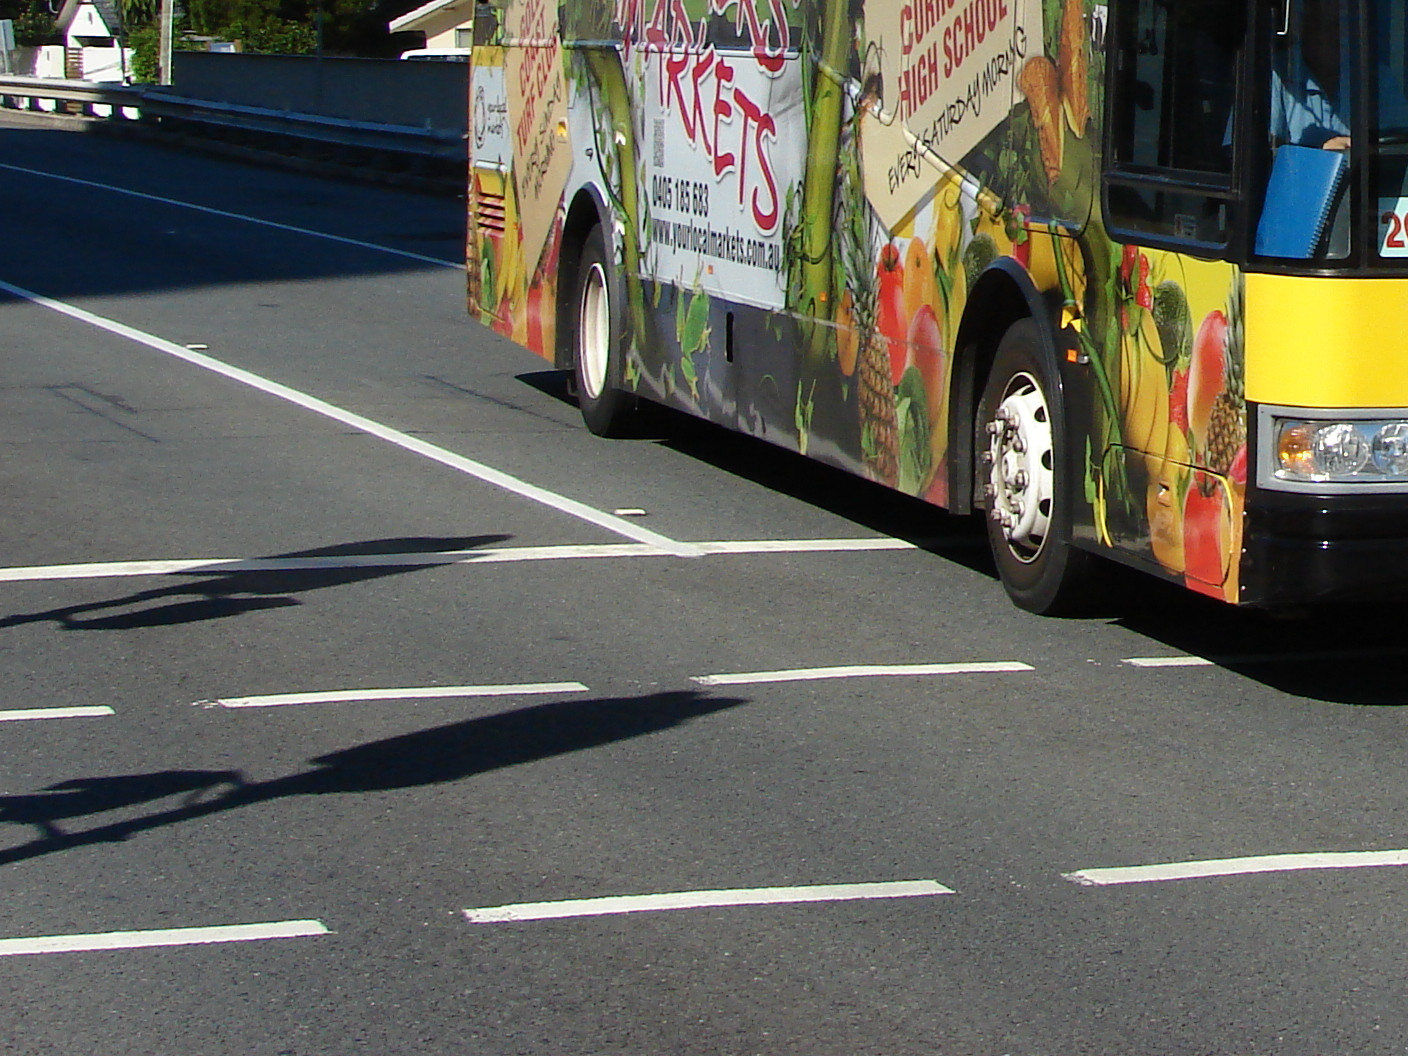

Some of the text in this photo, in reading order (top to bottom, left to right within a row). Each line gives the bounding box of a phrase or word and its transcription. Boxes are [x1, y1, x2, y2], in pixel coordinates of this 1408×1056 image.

[898, 40, 939, 122] HIGH
[922, 72, 980, 147] SATURDAY
[982, 25, 1028, 97] MORNNG
[516, 82, 536, 157] TURF
[652, 174, 672, 210] 0405
[675, 178, 690, 214] 185
[651, 218, 780, 272] www.yourlocalmarkets.com.au
